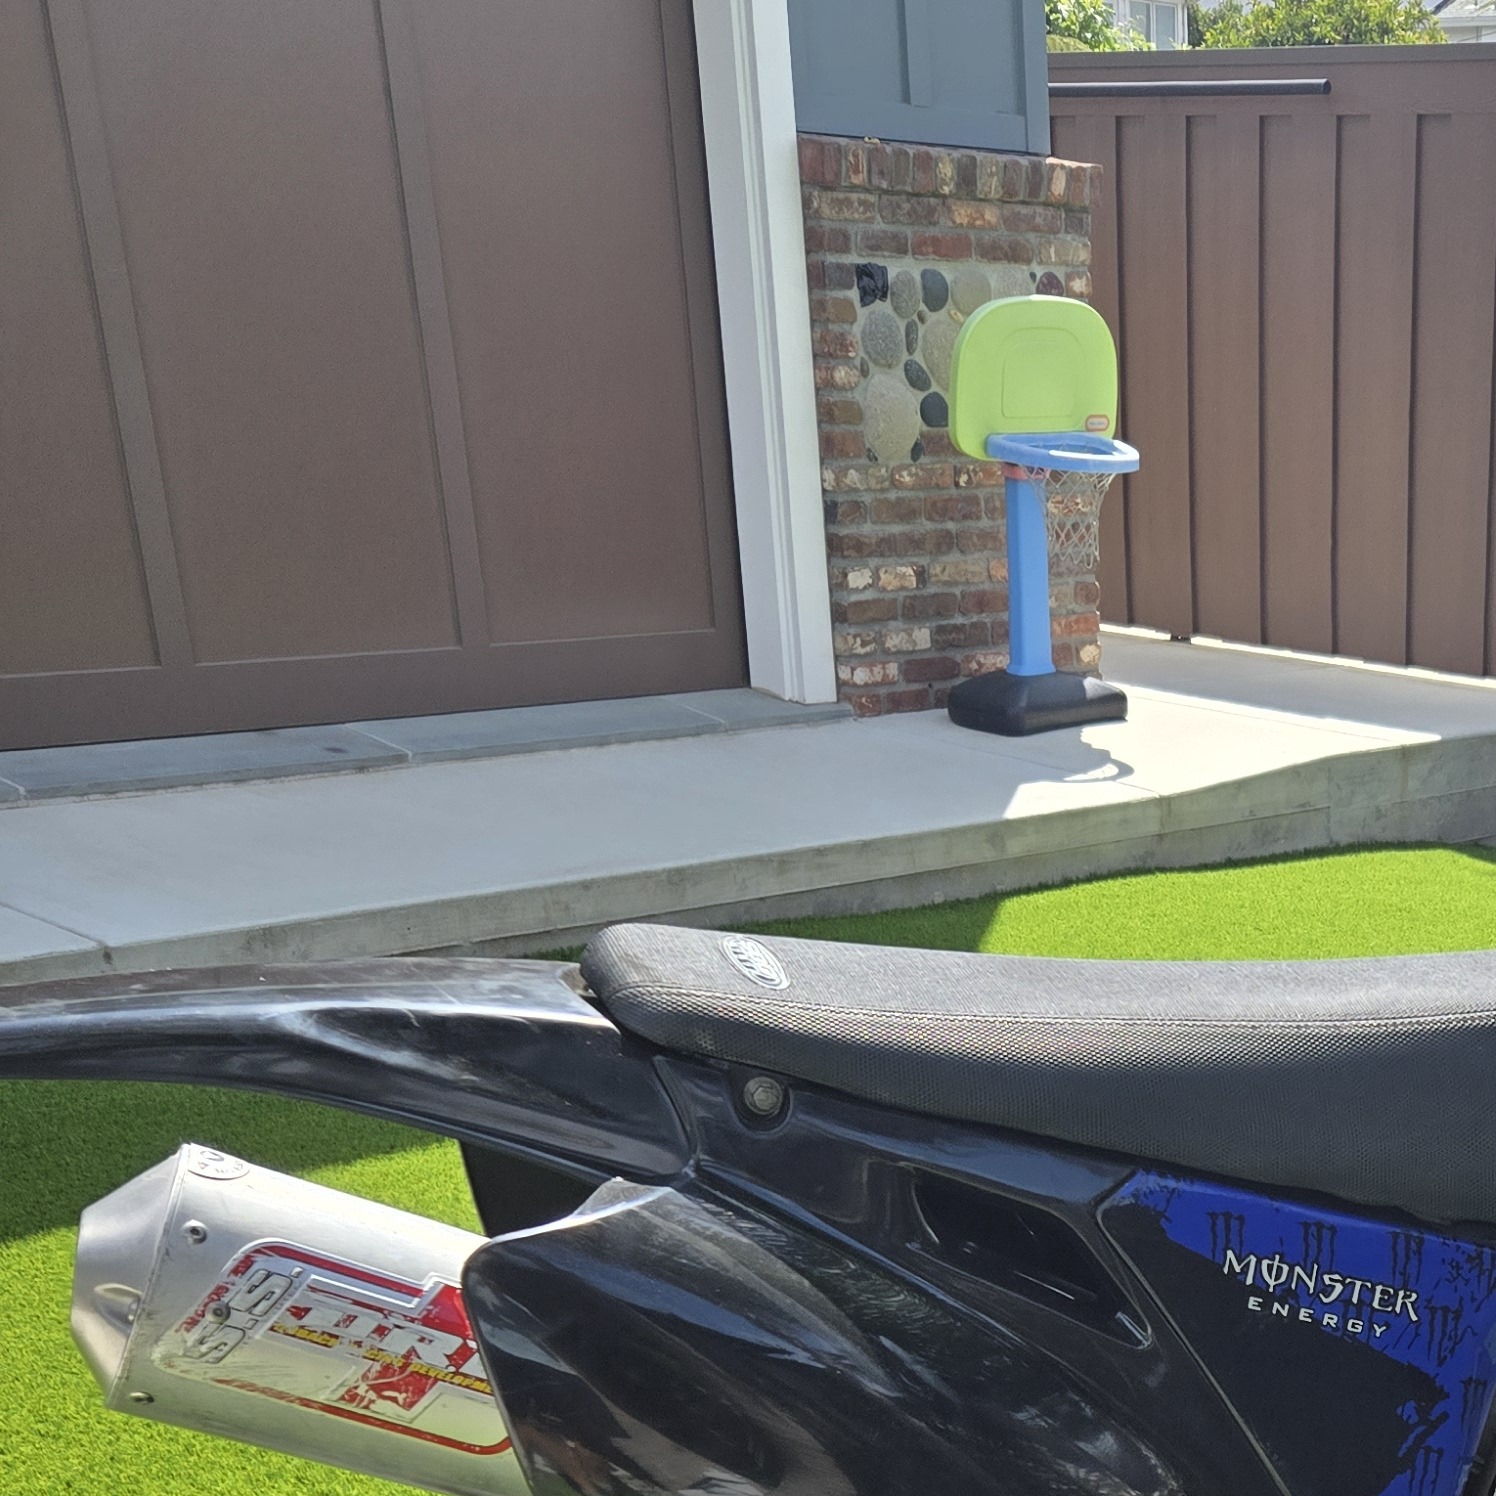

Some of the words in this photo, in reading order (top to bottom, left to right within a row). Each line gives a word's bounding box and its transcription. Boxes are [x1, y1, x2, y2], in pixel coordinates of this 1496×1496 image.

[1223, 1249, 1419, 1322] MONSTER
[1247, 1296, 1388, 1338] ENERGY
[409, 1361, 495, 1395] DEVELOPME
